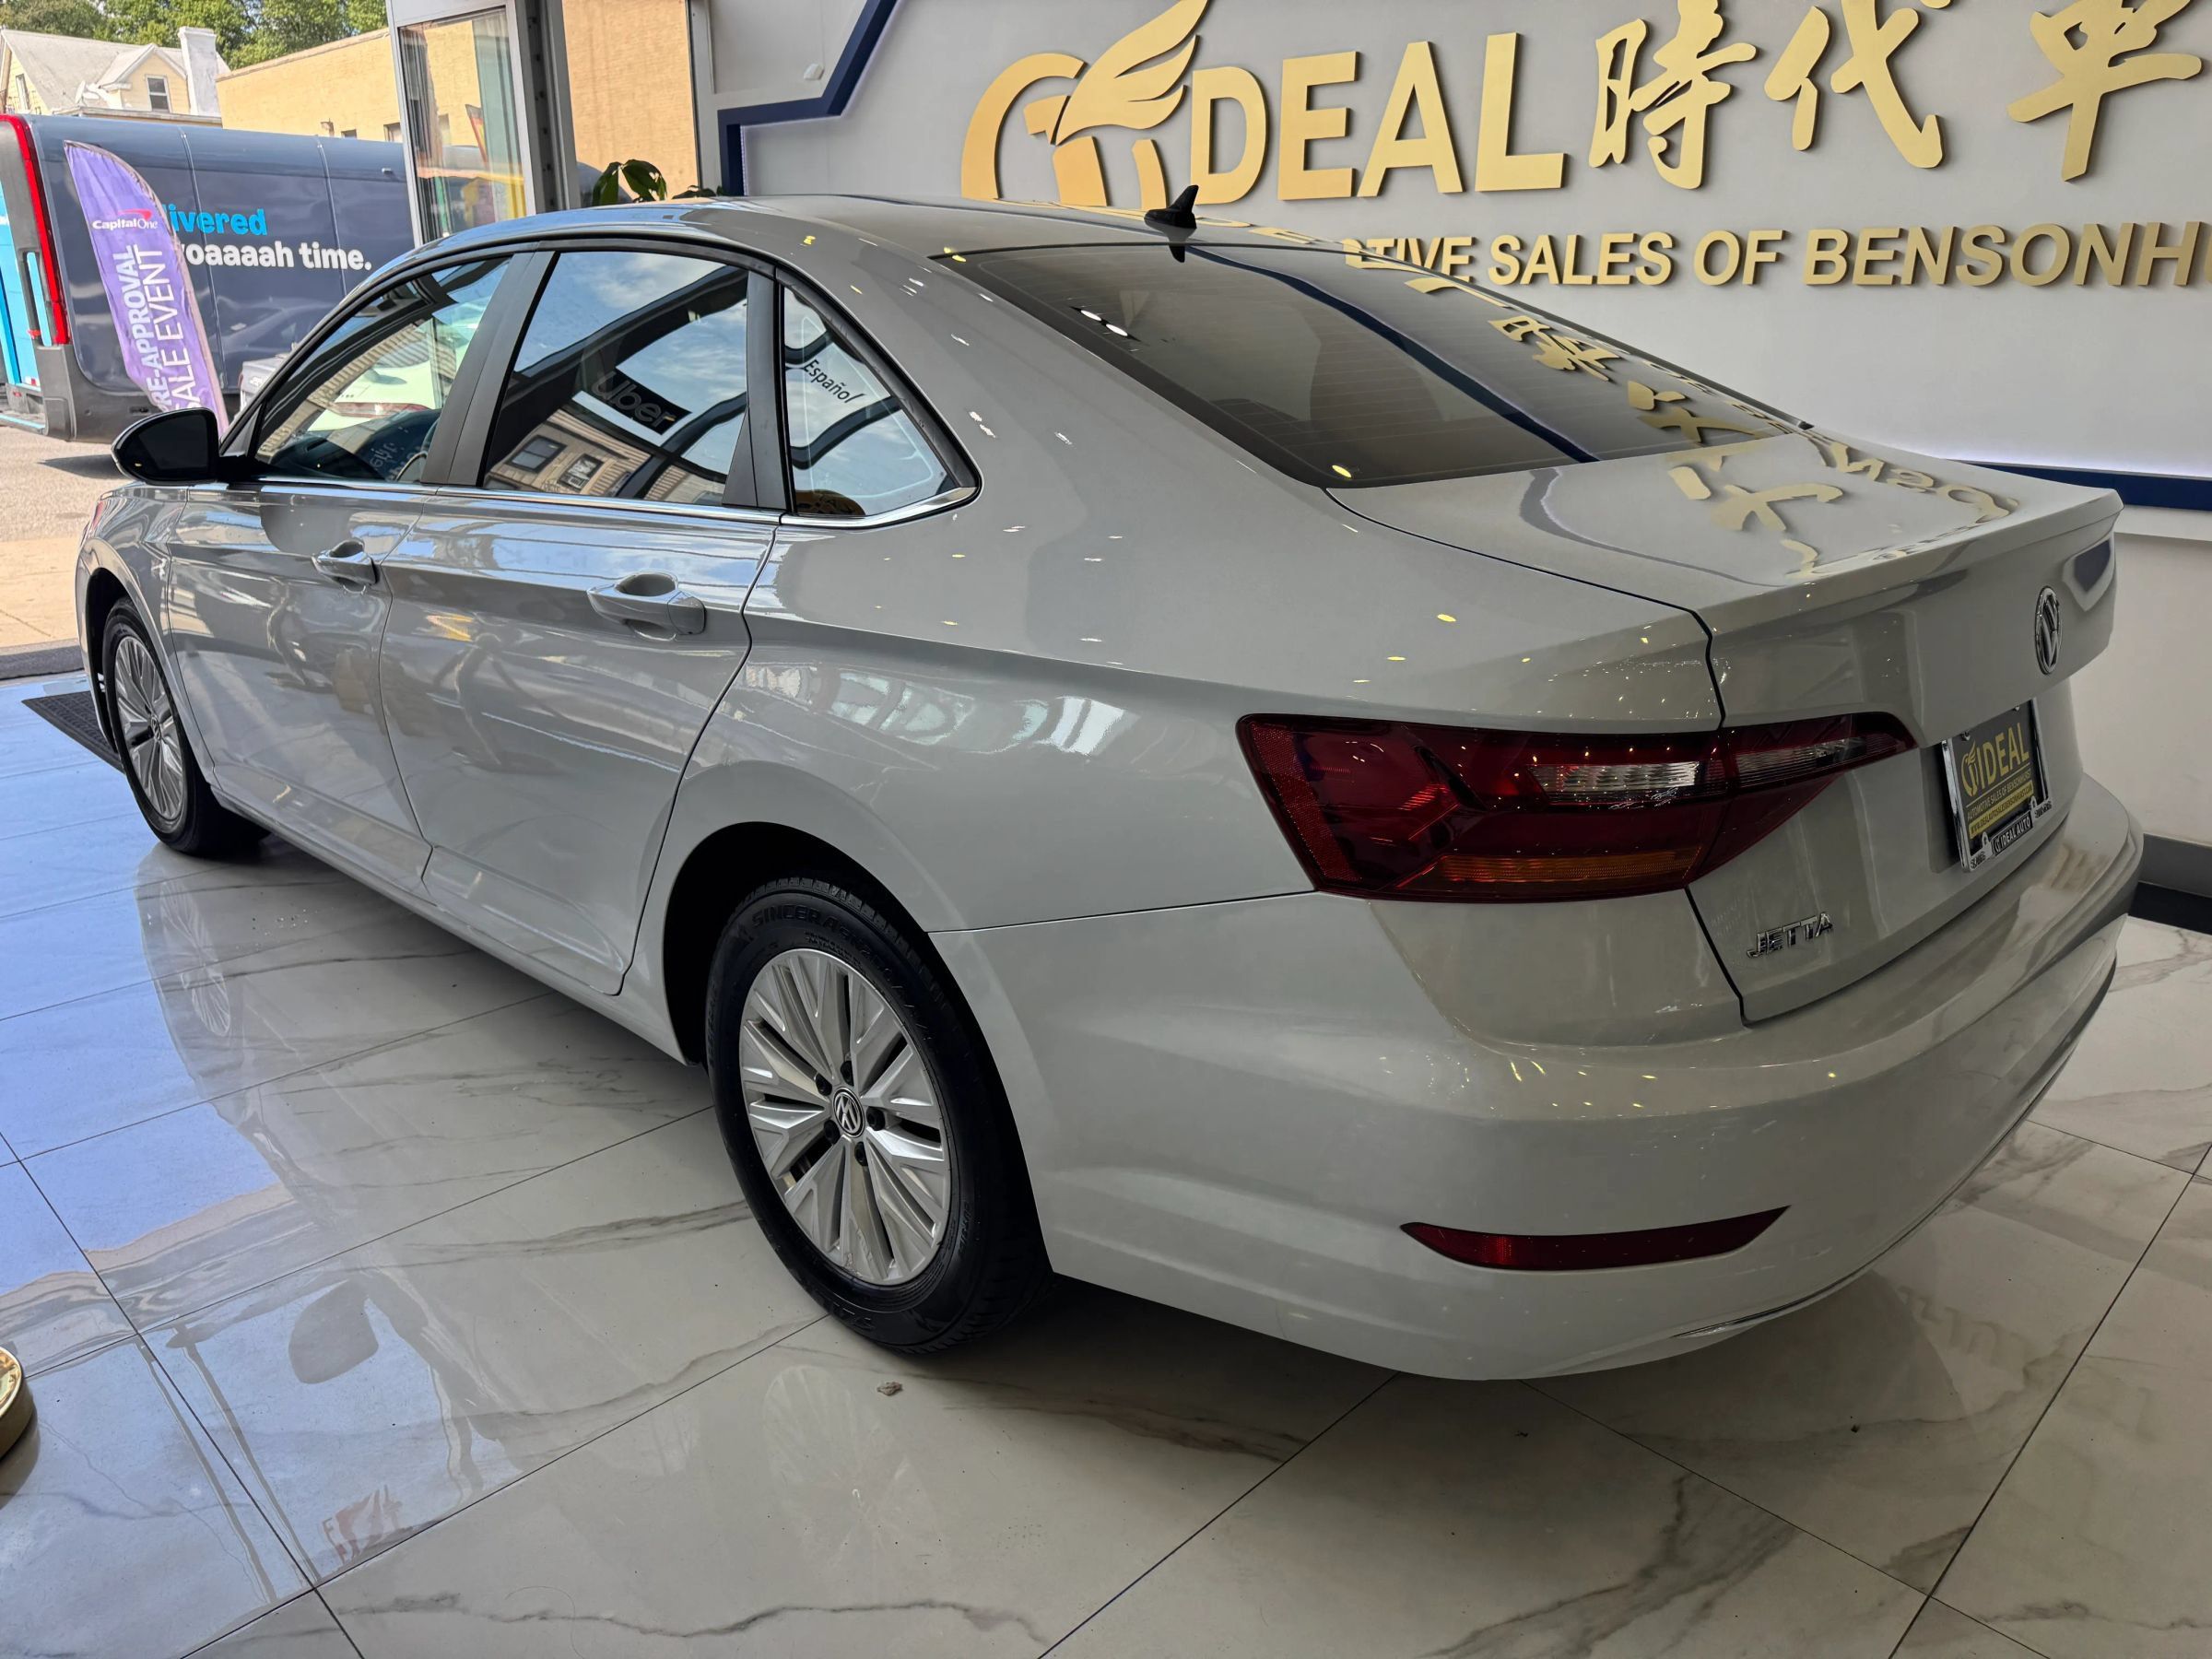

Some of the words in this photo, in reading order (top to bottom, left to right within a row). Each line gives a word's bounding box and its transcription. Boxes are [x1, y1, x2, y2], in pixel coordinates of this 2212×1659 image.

[182, 241, 294, 268] oaaaah
[299, 241, 372, 270] time.
[1488, 231, 1674, 286] SALES
[1693, 229, 1787, 286] OF
[1804, 221, 2212, 287] BENSONH
[134, 244, 183, 341] EVENT
[591, 371, 677, 428] Uber
[803, 359, 866, 404] Español
[1976, 723, 2030, 790] IDEAL
[1999, 826, 2017, 848] IDEAL
[2016, 815, 2030, 836] AUTO
[1747, 912, 1833, 957] JETTA
